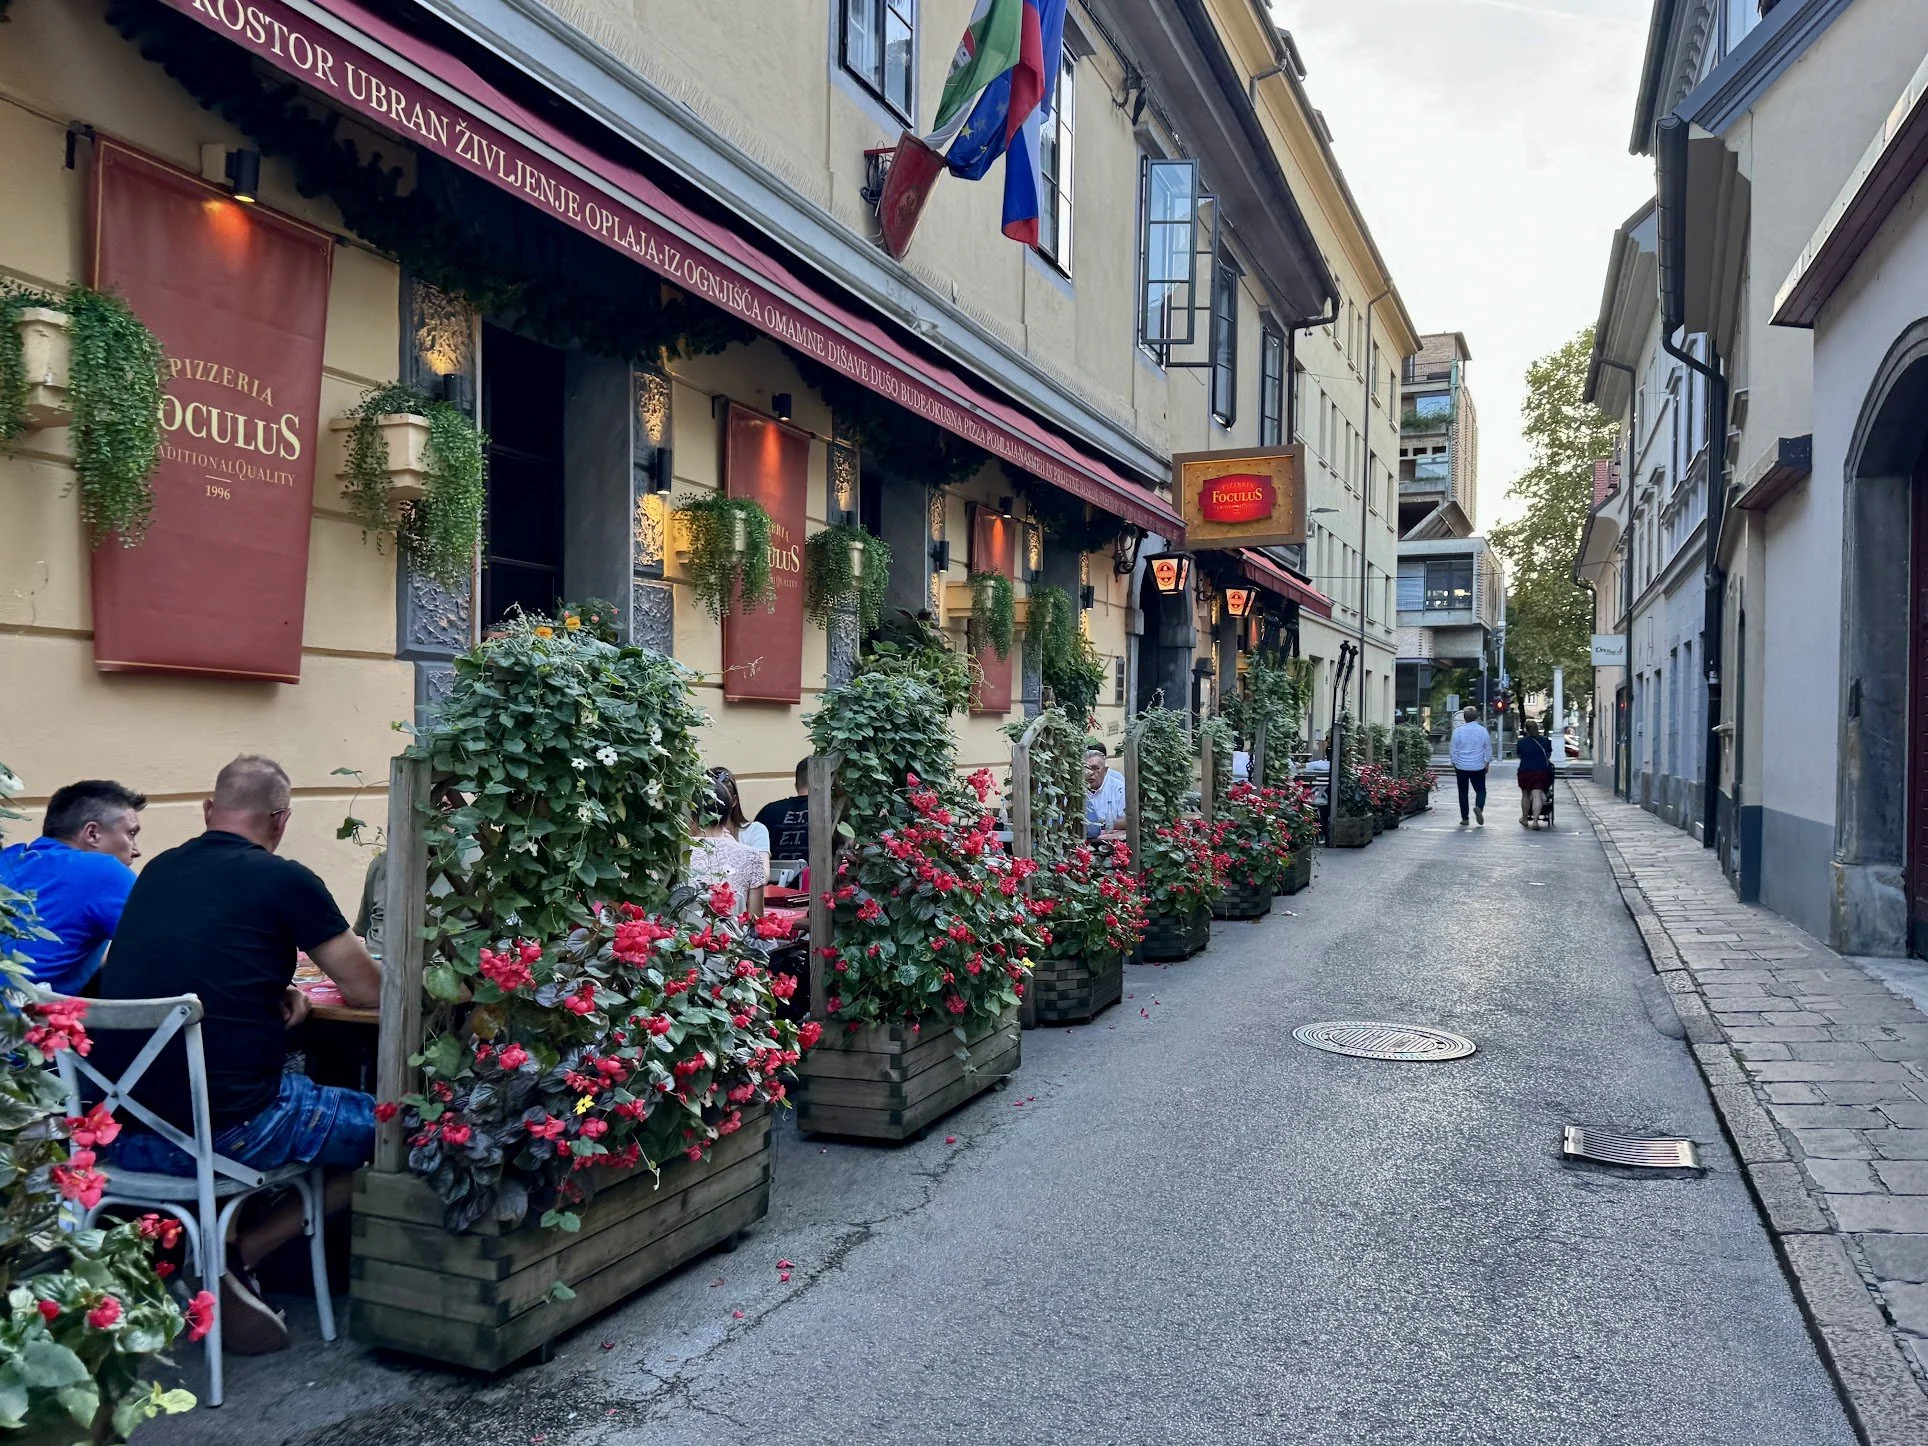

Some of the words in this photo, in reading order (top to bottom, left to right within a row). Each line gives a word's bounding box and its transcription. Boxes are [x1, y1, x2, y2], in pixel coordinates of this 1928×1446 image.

[344, 61, 449, 147] UBRAN
[455, 118, 581, 221] ŽIVLJENJE
[684, 259, 762, 321] OGNJIŠČA
[764, 305, 825, 357] OMAMNE
[828, 340, 868, 381] DIŠAVE
[870, 365, 899, 397] DUŠO
[964, 417, 986, 444] PIZZA
[168, 358, 274, 408] PIZZERIA
[157, 394, 300, 460] OCULUS
[205, 484, 231, 501] 1996
[1212, 487, 1263, 504] FOCULUS
[768, 544, 800, 573] ULUS
